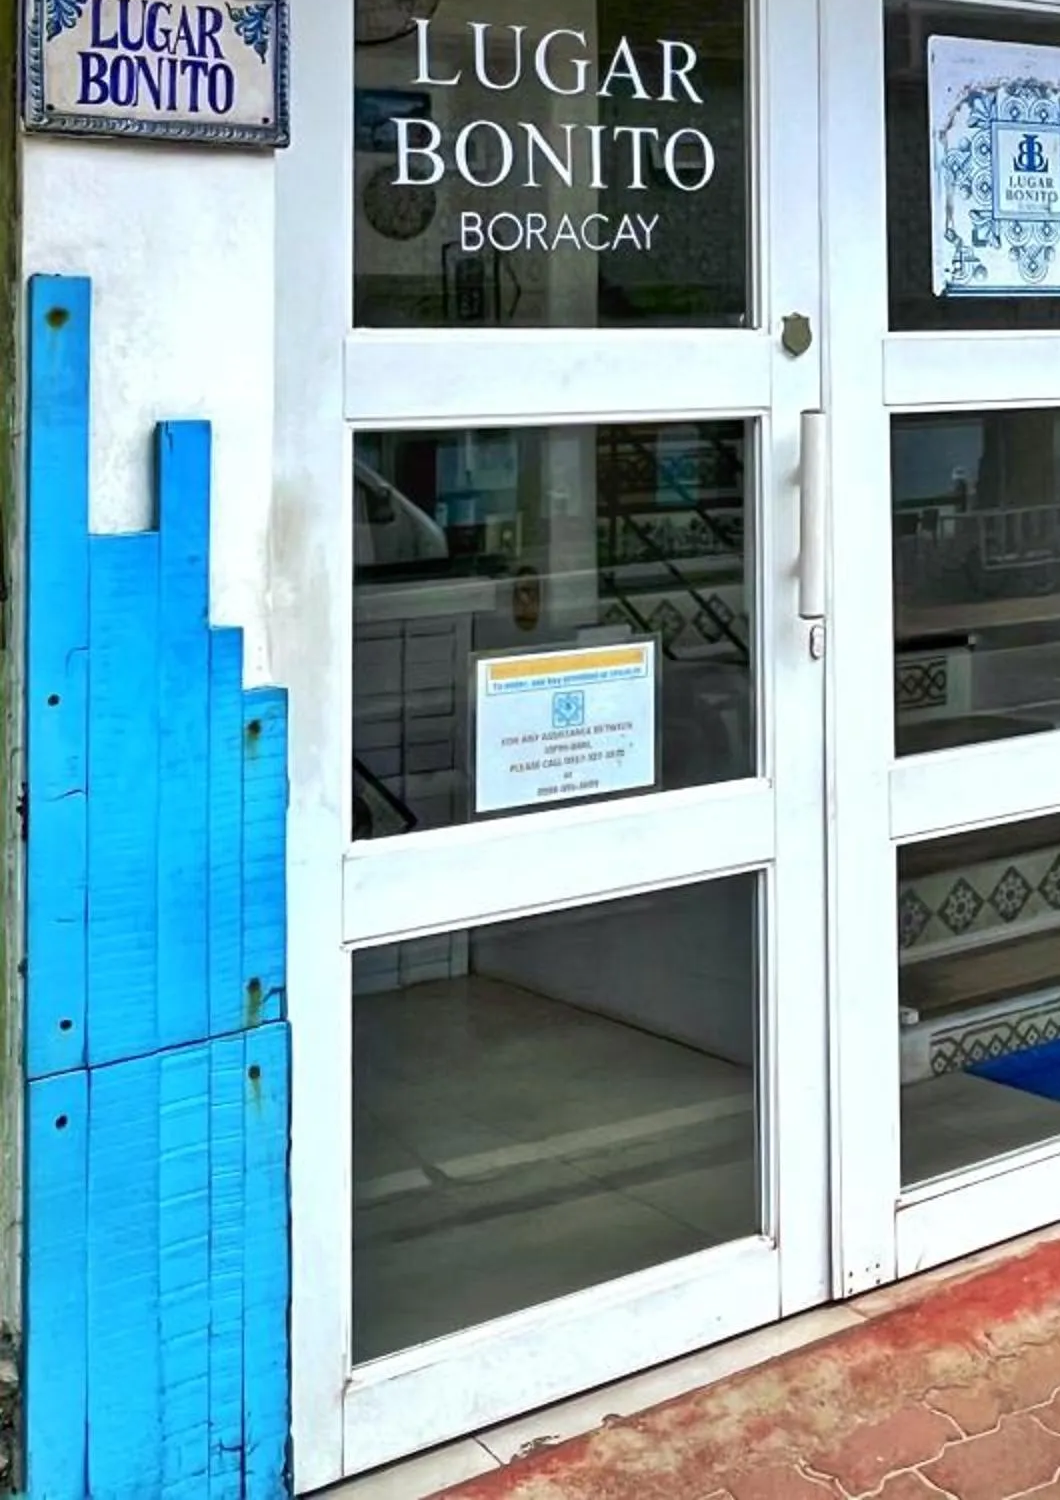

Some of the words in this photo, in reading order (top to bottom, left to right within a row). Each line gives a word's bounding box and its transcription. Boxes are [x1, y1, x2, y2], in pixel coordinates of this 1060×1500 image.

[410, 17, 704, 104] LUGAR
[77, 51, 234, 114] BONITO
[389, 117, 716, 192] BONITO
[1005, 189, 1059, 203] BONITO
[1009, 175, 1055, 189] LUGAR
[460, 211, 660, 252] BORACAY
[509, 760, 540, 773] PLEASE
[542, 757, 562, 769] CALL
